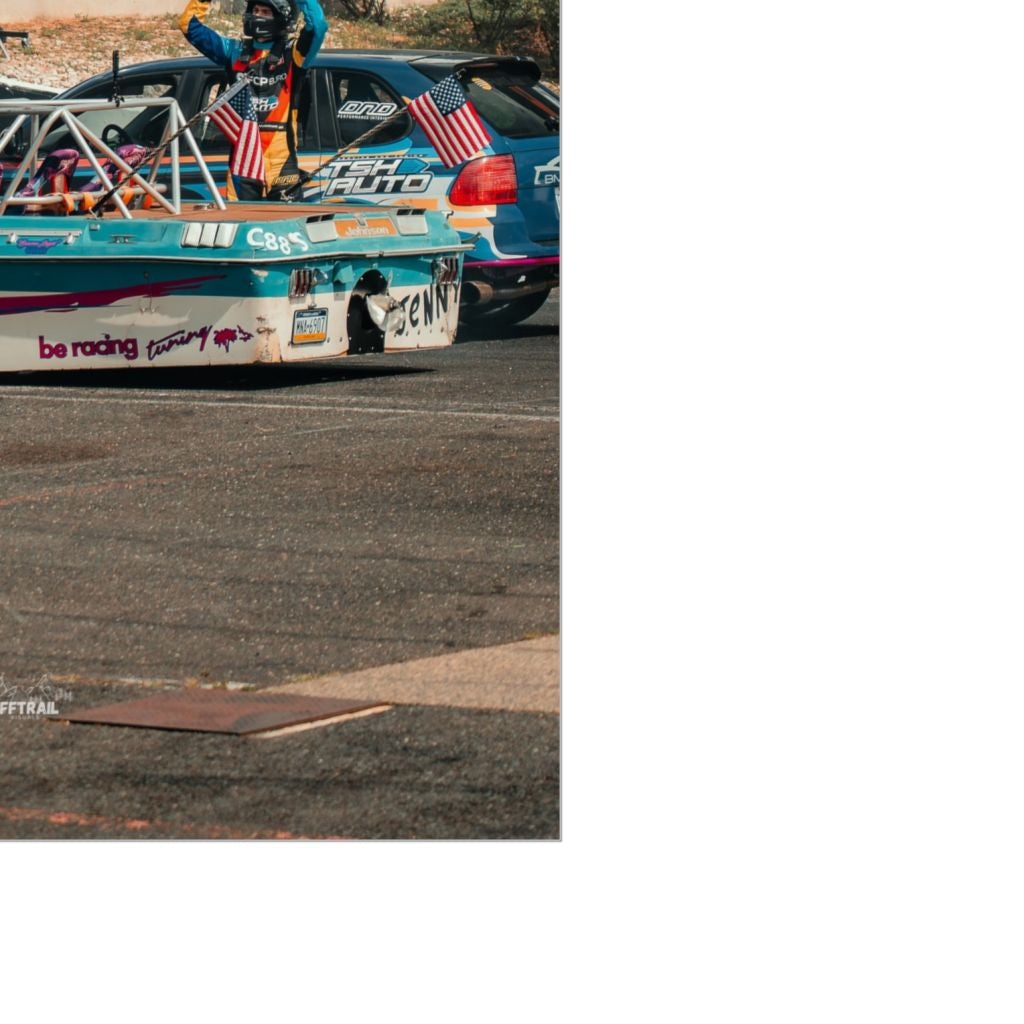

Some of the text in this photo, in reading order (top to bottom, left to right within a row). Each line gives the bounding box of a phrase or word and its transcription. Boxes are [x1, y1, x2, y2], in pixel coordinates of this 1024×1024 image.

[328, 159, 402, 177] TSH
[325, 175, 432, 196] AUTO
[38, 335, 68, 359] be
[72, 333, 138, 360] racing
